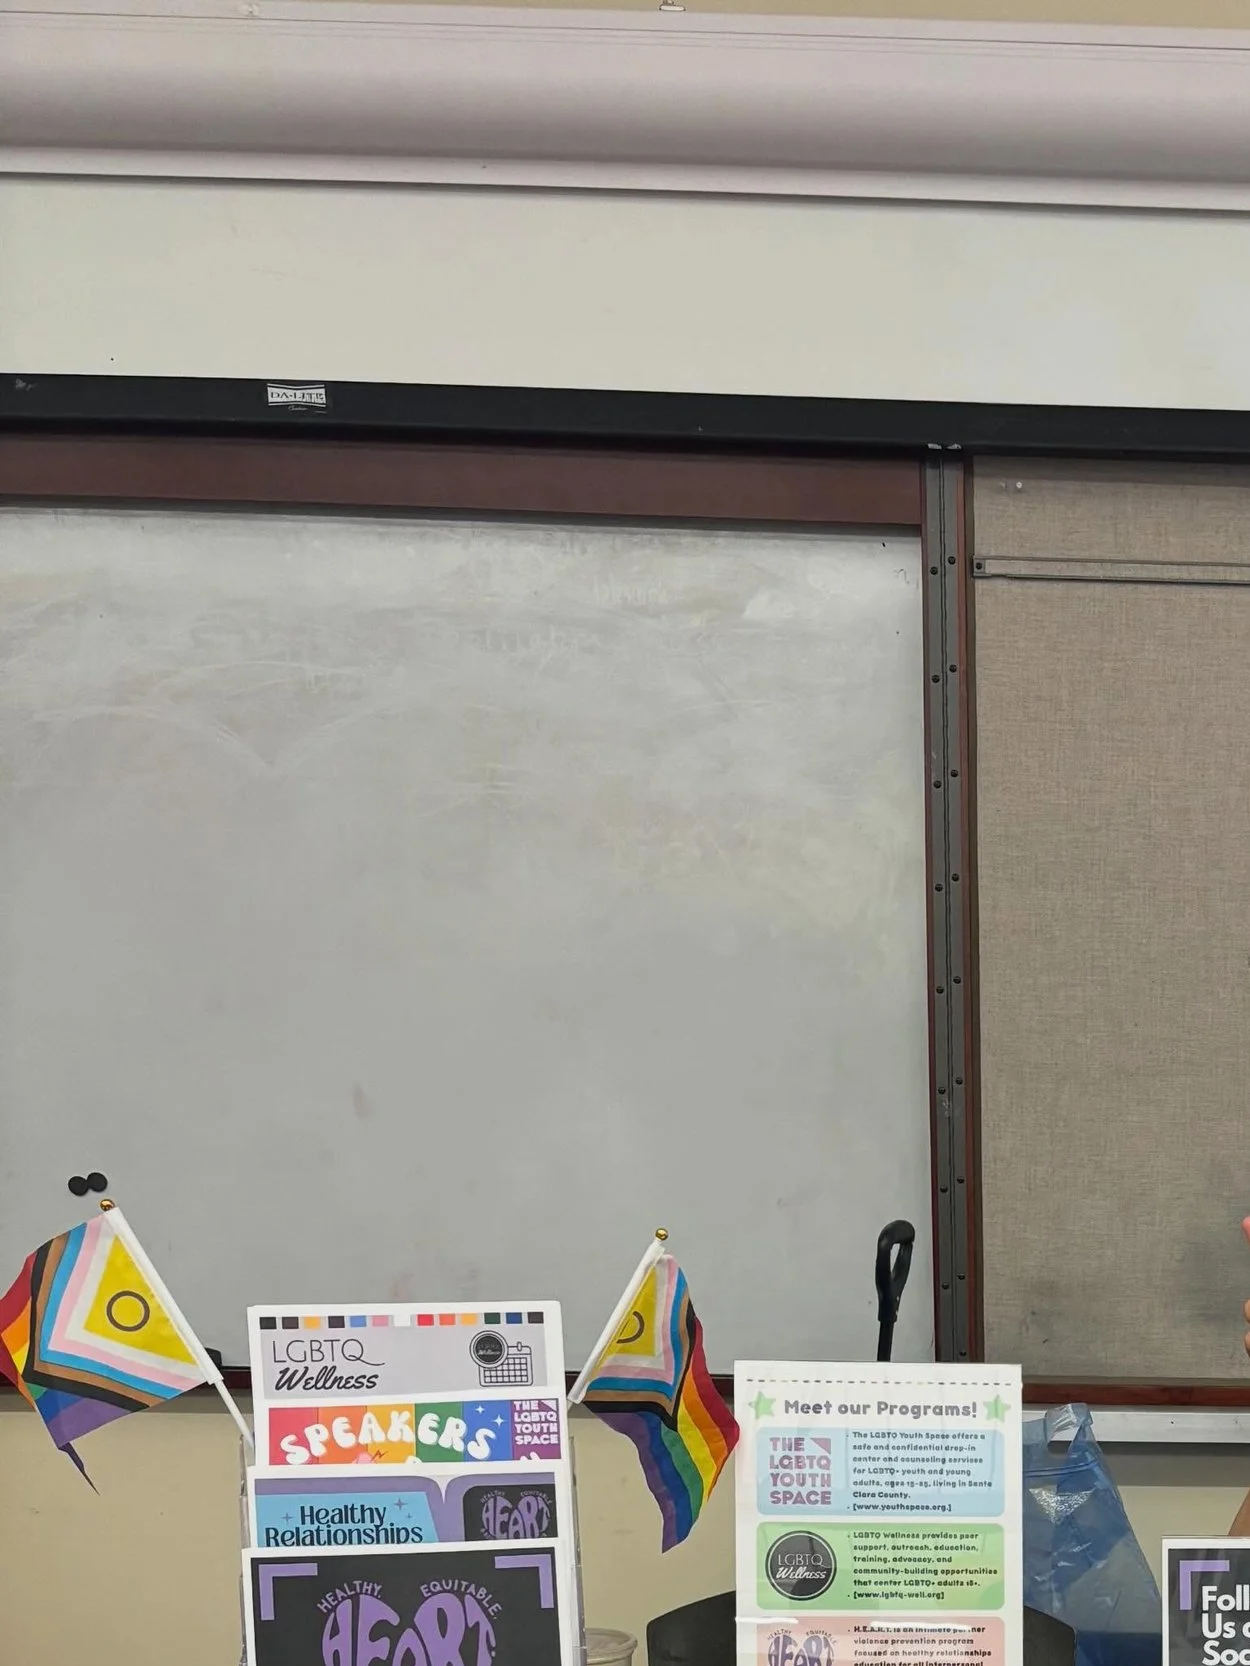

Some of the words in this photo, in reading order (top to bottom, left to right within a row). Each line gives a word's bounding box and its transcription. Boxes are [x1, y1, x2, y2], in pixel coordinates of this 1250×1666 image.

[272, 1339, 385, 1365] LGBTQ
[275, 1366, 379, 1390] Wellness
[514, 1401, 539, 1410] THE
[784, 1399, 832, 1415] Meet
[838, 1402, 871, 1415] our
[877, 1401, 977, 1419] Programs!
[514, 1411, 557, 1422] LGBTQ
[515, 1423, 558, 1433] YOUTH
[280, 1411, 496, 1465] SPEAKERS
[515, 1434, 558, 1445] SPACE
[769, 1437, 804, 1452] THE
[769, 1455, 830, 1470] LGBTQ
[770, 1473, 831, 1487] YOUTH
[770, 1491, 831, 1505] SPACE
[300, 1504, 387, 1531] Healthy
[265, 1523, 423, 1547] Relationships
[778, 1554, 827, 1567] LGBTQ
[775, 1565, 827, 1580] Wellness
[1202, 1612, 1235, 1639] Us
